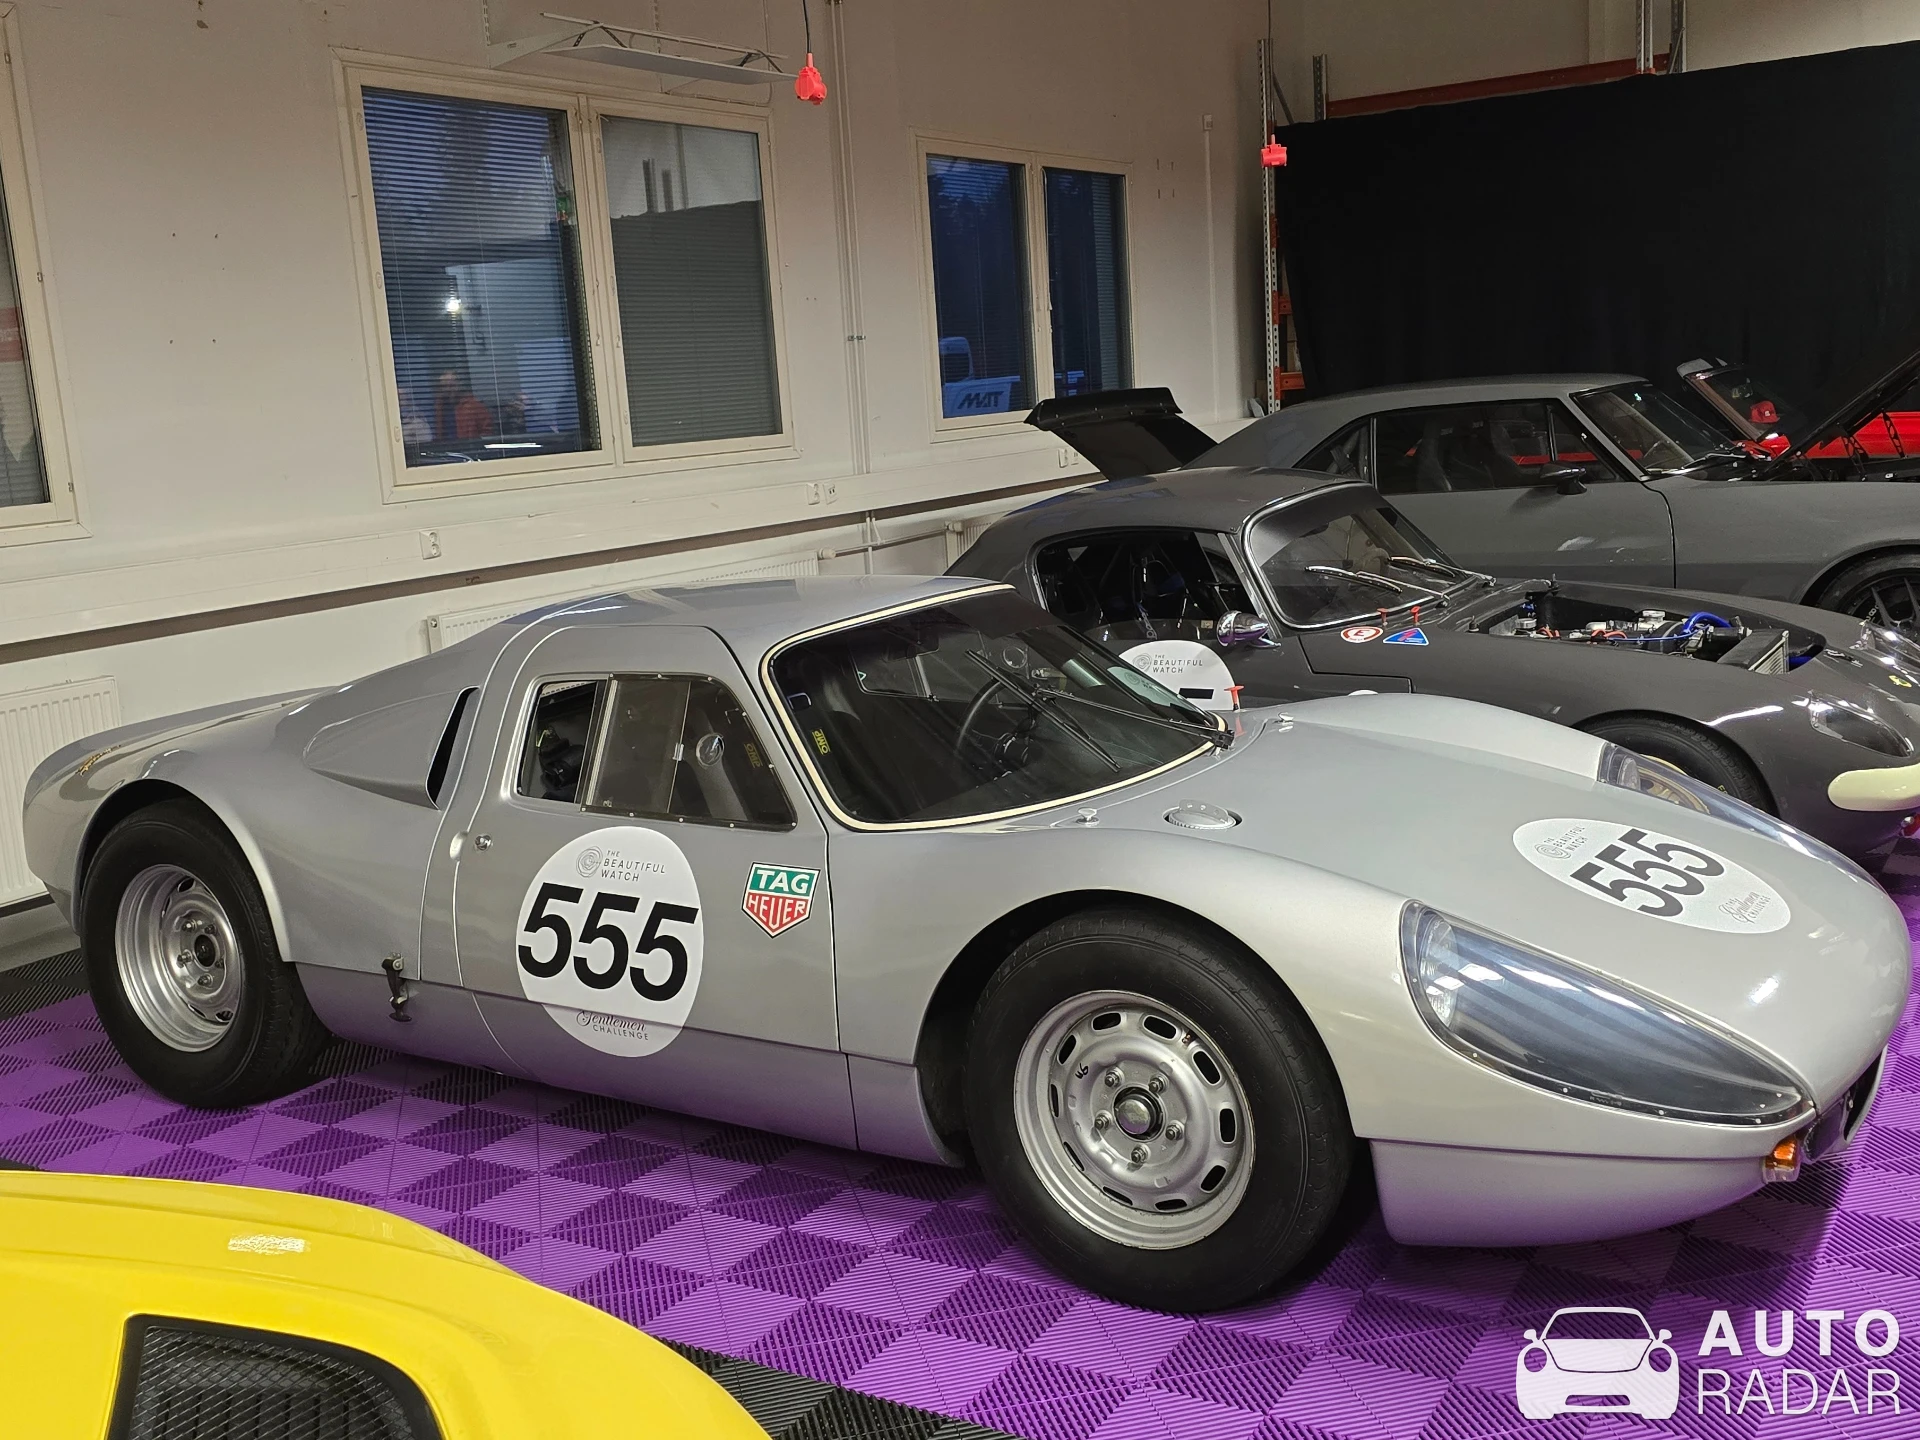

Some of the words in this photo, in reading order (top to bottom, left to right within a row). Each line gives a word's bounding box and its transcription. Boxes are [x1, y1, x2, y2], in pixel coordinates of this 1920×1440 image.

[1152, 666, 1184, 674] WATCH
[813, 730, 829, 754] OMP
[601, 869, 640, 882] WATCH
[603, 858, 666, 874] BEAUTIFUL
[1569, 828, 1725, 917] 555
[756, 869, 810, 894] TAG
[748, 894, 806, 930] HEUER
[518, 882, 699, 1001] 555
[576, 1010, 647, 1032] Gentlemen
[592, 1024, 649, 1041] CHALLENGE
